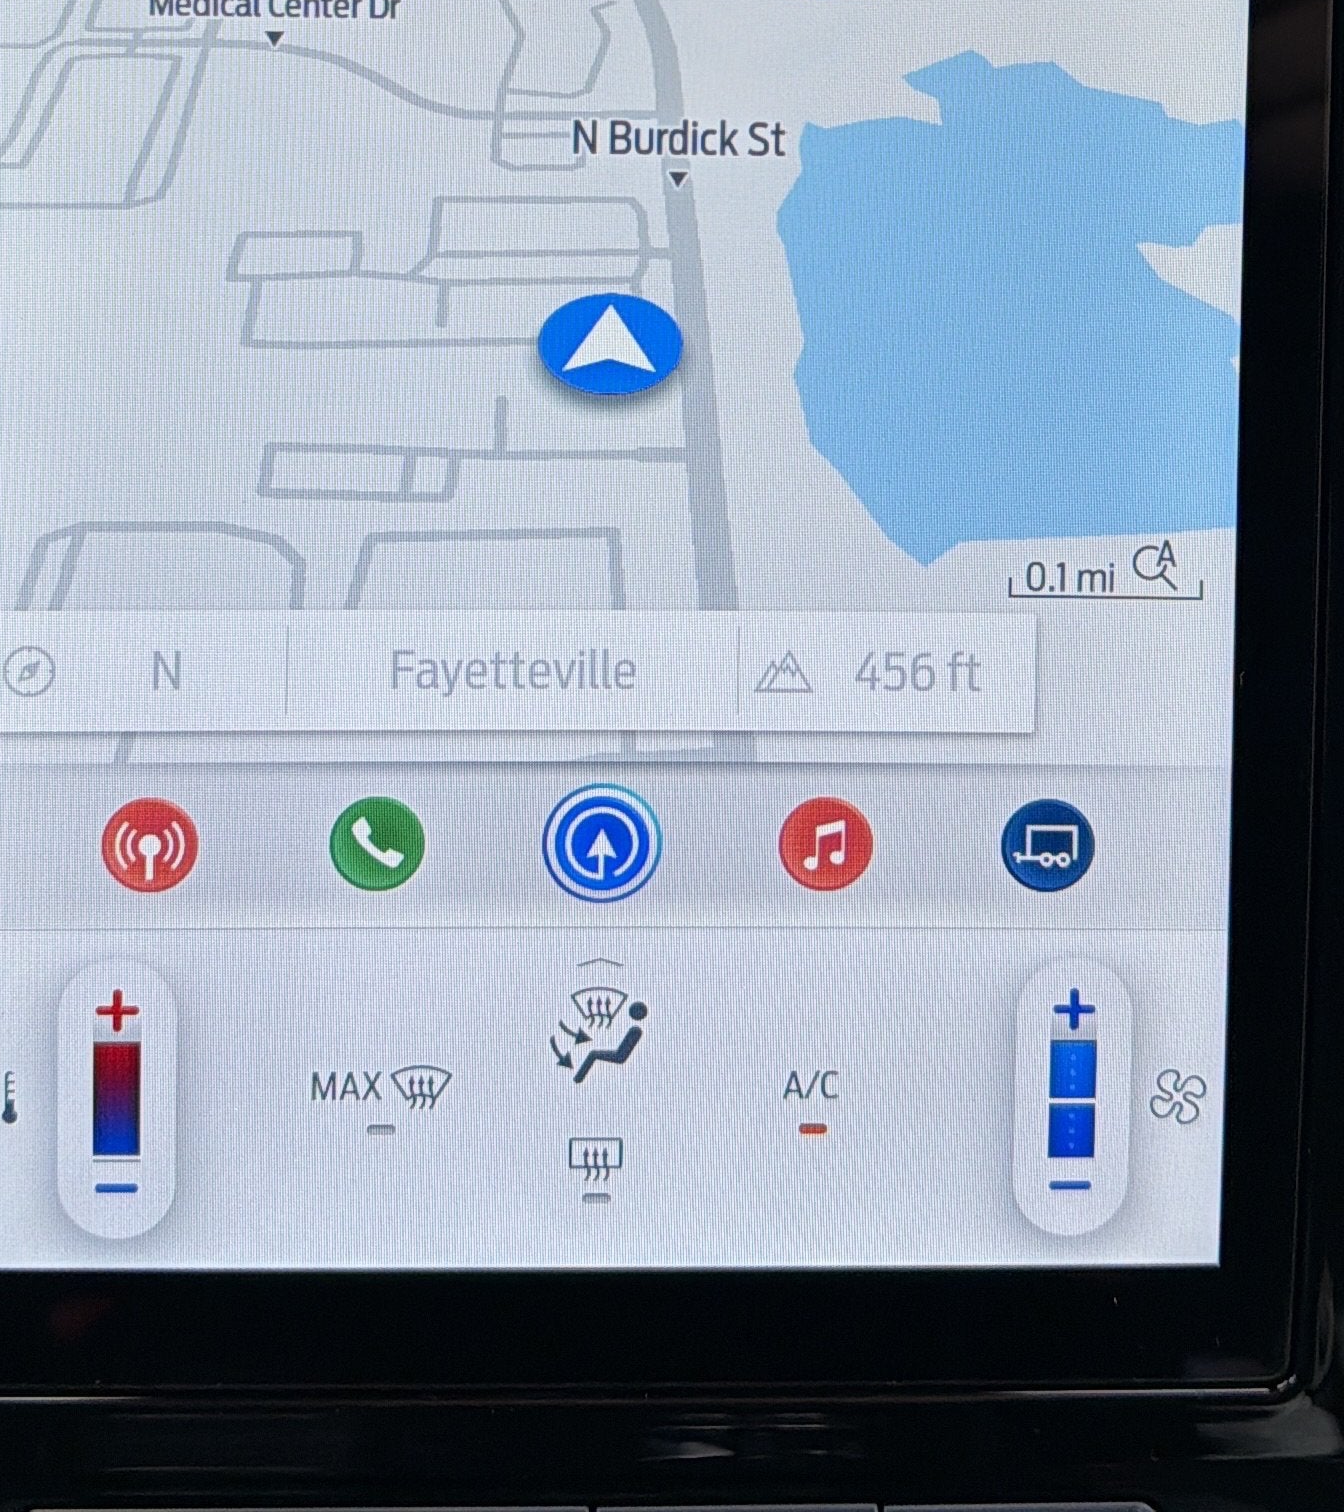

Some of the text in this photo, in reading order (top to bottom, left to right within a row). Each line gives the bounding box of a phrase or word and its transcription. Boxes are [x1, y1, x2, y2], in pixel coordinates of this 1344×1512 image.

[572, 118, 786, 157] N Burdick St
[1025, 560, 1115, 594] 0.1 mi
[152, 650, 182, 691] N
[391, 648, 637, 698] Fayetteville
[854, 650, 982, 693] 456 ft
[309, 1071, 383, 1102] MAX
[782, 1068, 840, 1100] A/C
